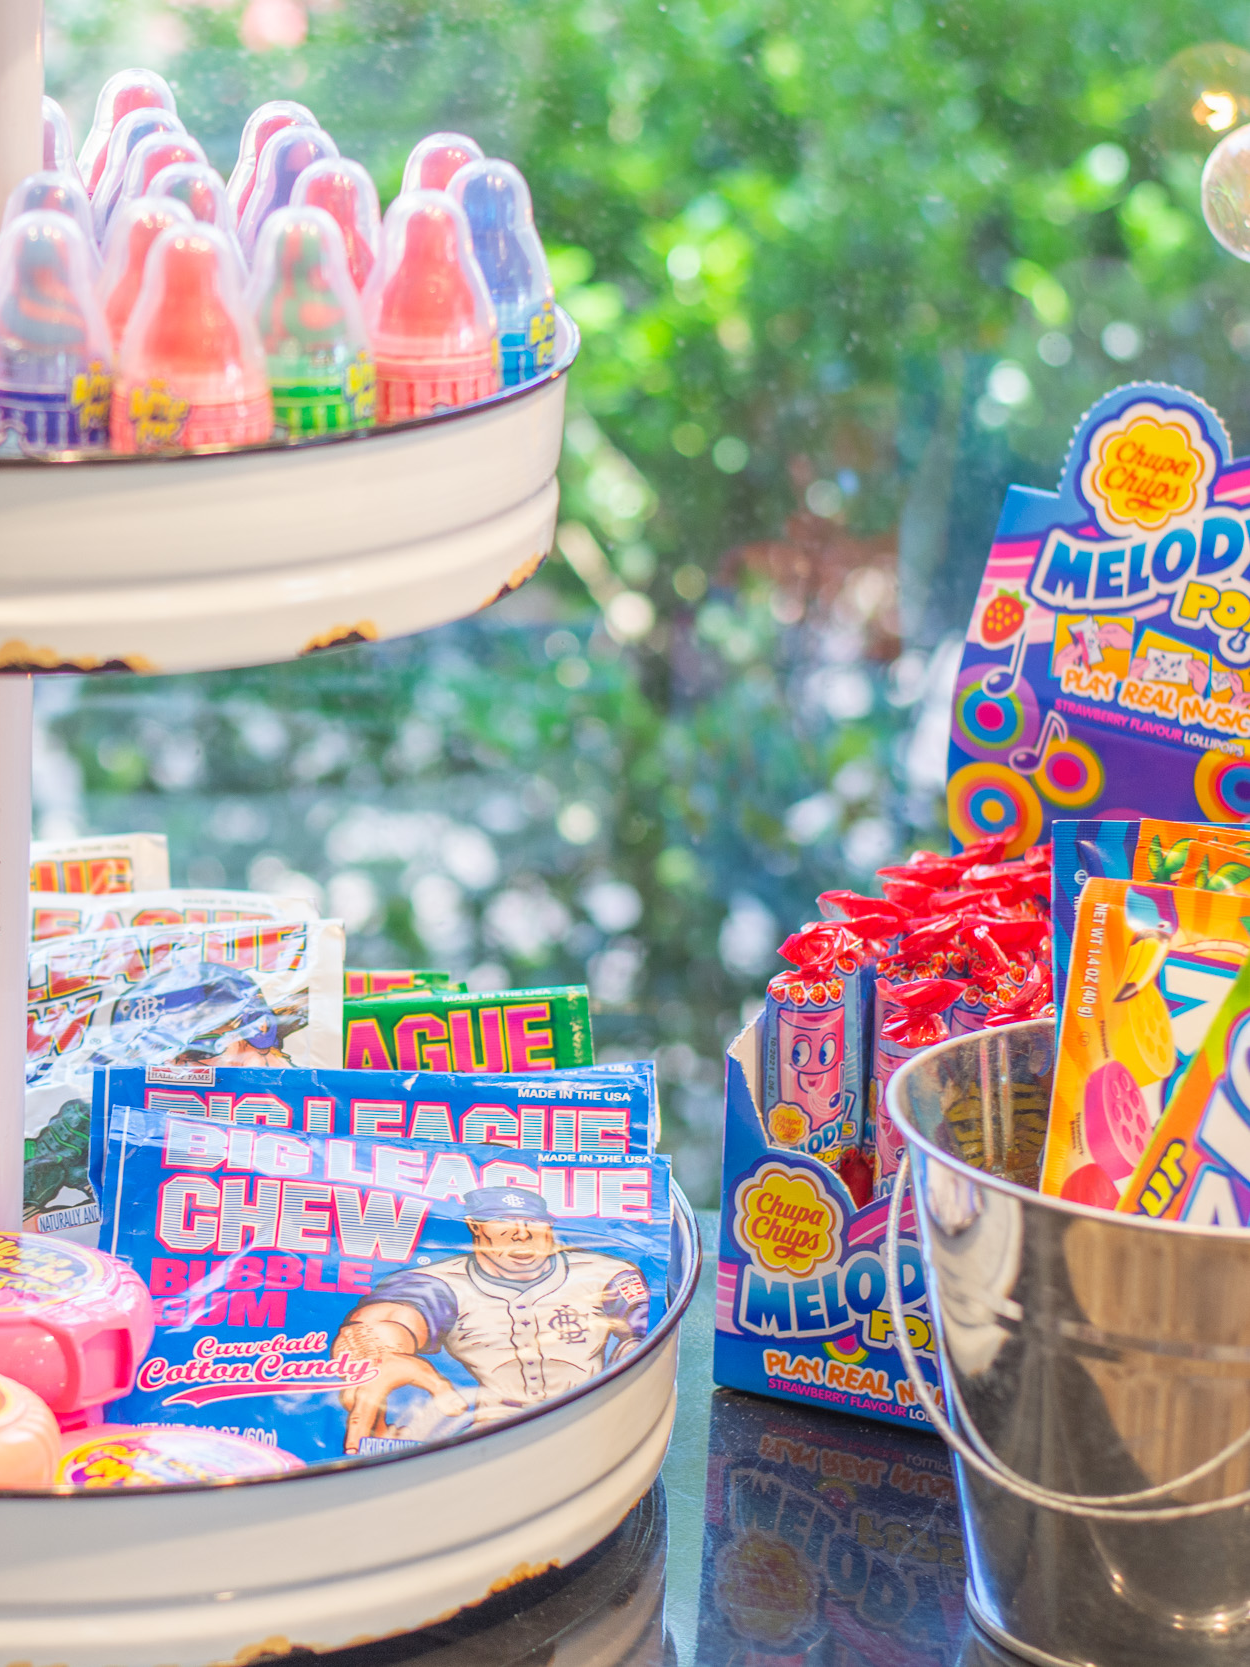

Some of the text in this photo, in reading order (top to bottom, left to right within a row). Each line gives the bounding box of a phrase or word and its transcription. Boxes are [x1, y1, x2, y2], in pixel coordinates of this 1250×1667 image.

[1113, 437, 1194, 479] Chupa
[1103, 466, 1183, 505] Chups
[1040, 515, 1250, 602] MELOD
[1178, 579, 1250, 632] PO
[1062, 667, 1114, 701] PLAY
[1121, 683, 1175, 715] REAL
[1053, 697, 1245, 758] STRAWBERRY FLAVOUR LOLLIPOPS
[1092, 902, 1110, 926] NET
[1089, 927, 1105, 947] WT
[1084, 967, 1100, 984] OZ
[1086, 949, 1102, 967] 1.4
[443, 988, 551, 1003] MADE IN THE USA
[344, 1002, 556, 1073] AGUE
[151, 1072, 173, 1080] HALL
[187, 1073, 211, 1081] FAME
[517, 1088, 632, 1102] MADE IN THE USA
[161, 1117, 654, 1224] BIG LEAGUE
[538, 1152, 652, 1165] MADE IN THE USA
[38, 1207, 82, 1233] NATURALLY
[155, 1173, 433, 1264] CHEW
[756, 1191, 826, 1228] Chupa
[751, 1216, 821, 1252] Chups
[150, 1255, 375, 1296] BUBBLE
[744, 1244, 928, 1333] MELOD
[154, 1290, 289, 1328] GUM
[193, 1331, 329, 1360] Curveball
[137, 1352, 381, 1393] Cotton Candy
[764, 1350, 823, 1384] PLAY
[826, 1365, 892, 1400] REAL
[767, 1378, 848, 1405] STRAWBERRY
[850, 1395, 908, 1419] FLAVOUR
